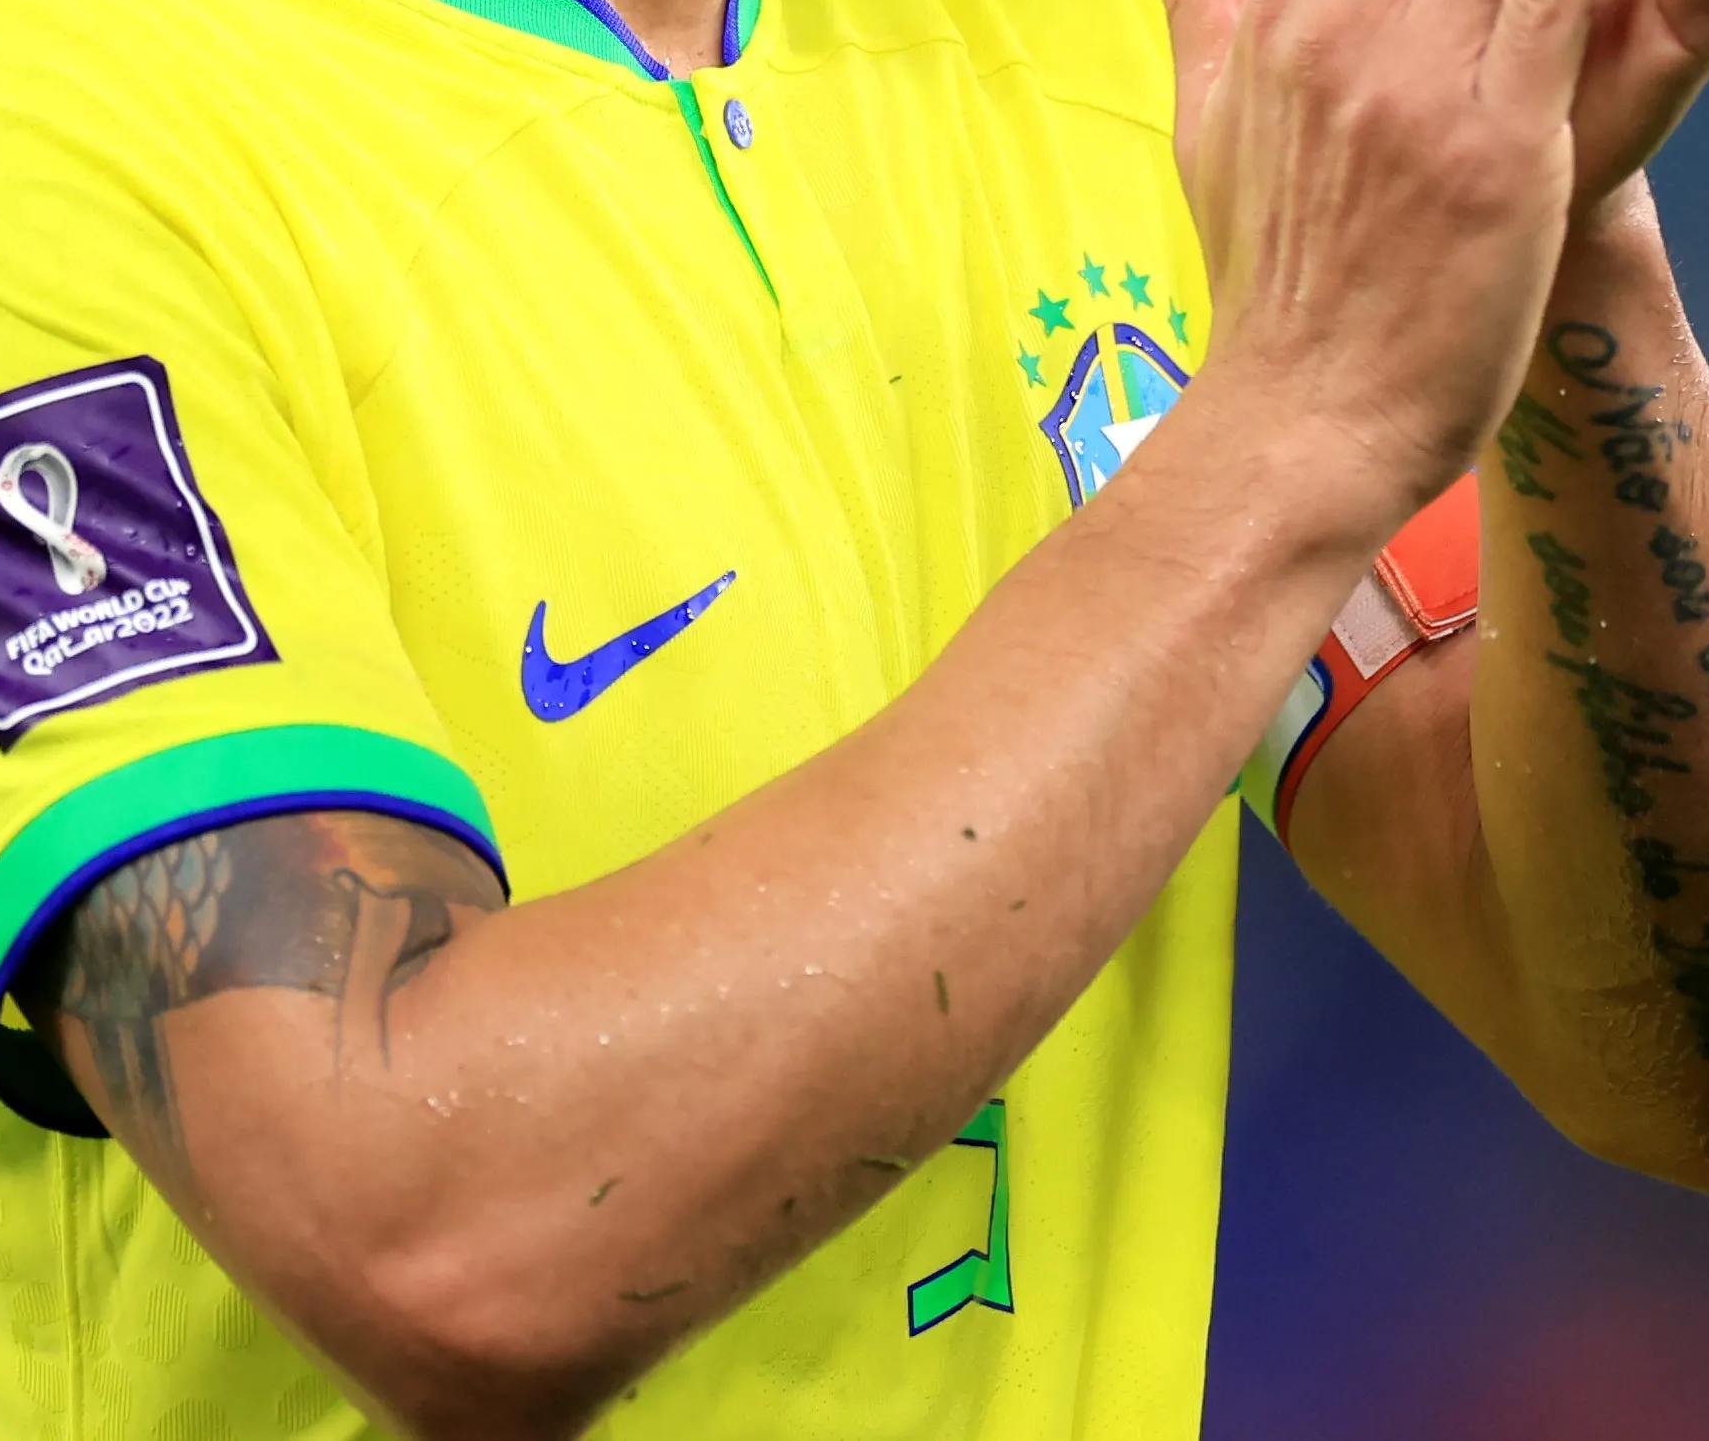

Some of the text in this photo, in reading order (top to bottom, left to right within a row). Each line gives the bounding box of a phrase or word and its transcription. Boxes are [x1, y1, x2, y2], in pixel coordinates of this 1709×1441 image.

[4, 577, 192, 661] FIFA WORLD CUP
